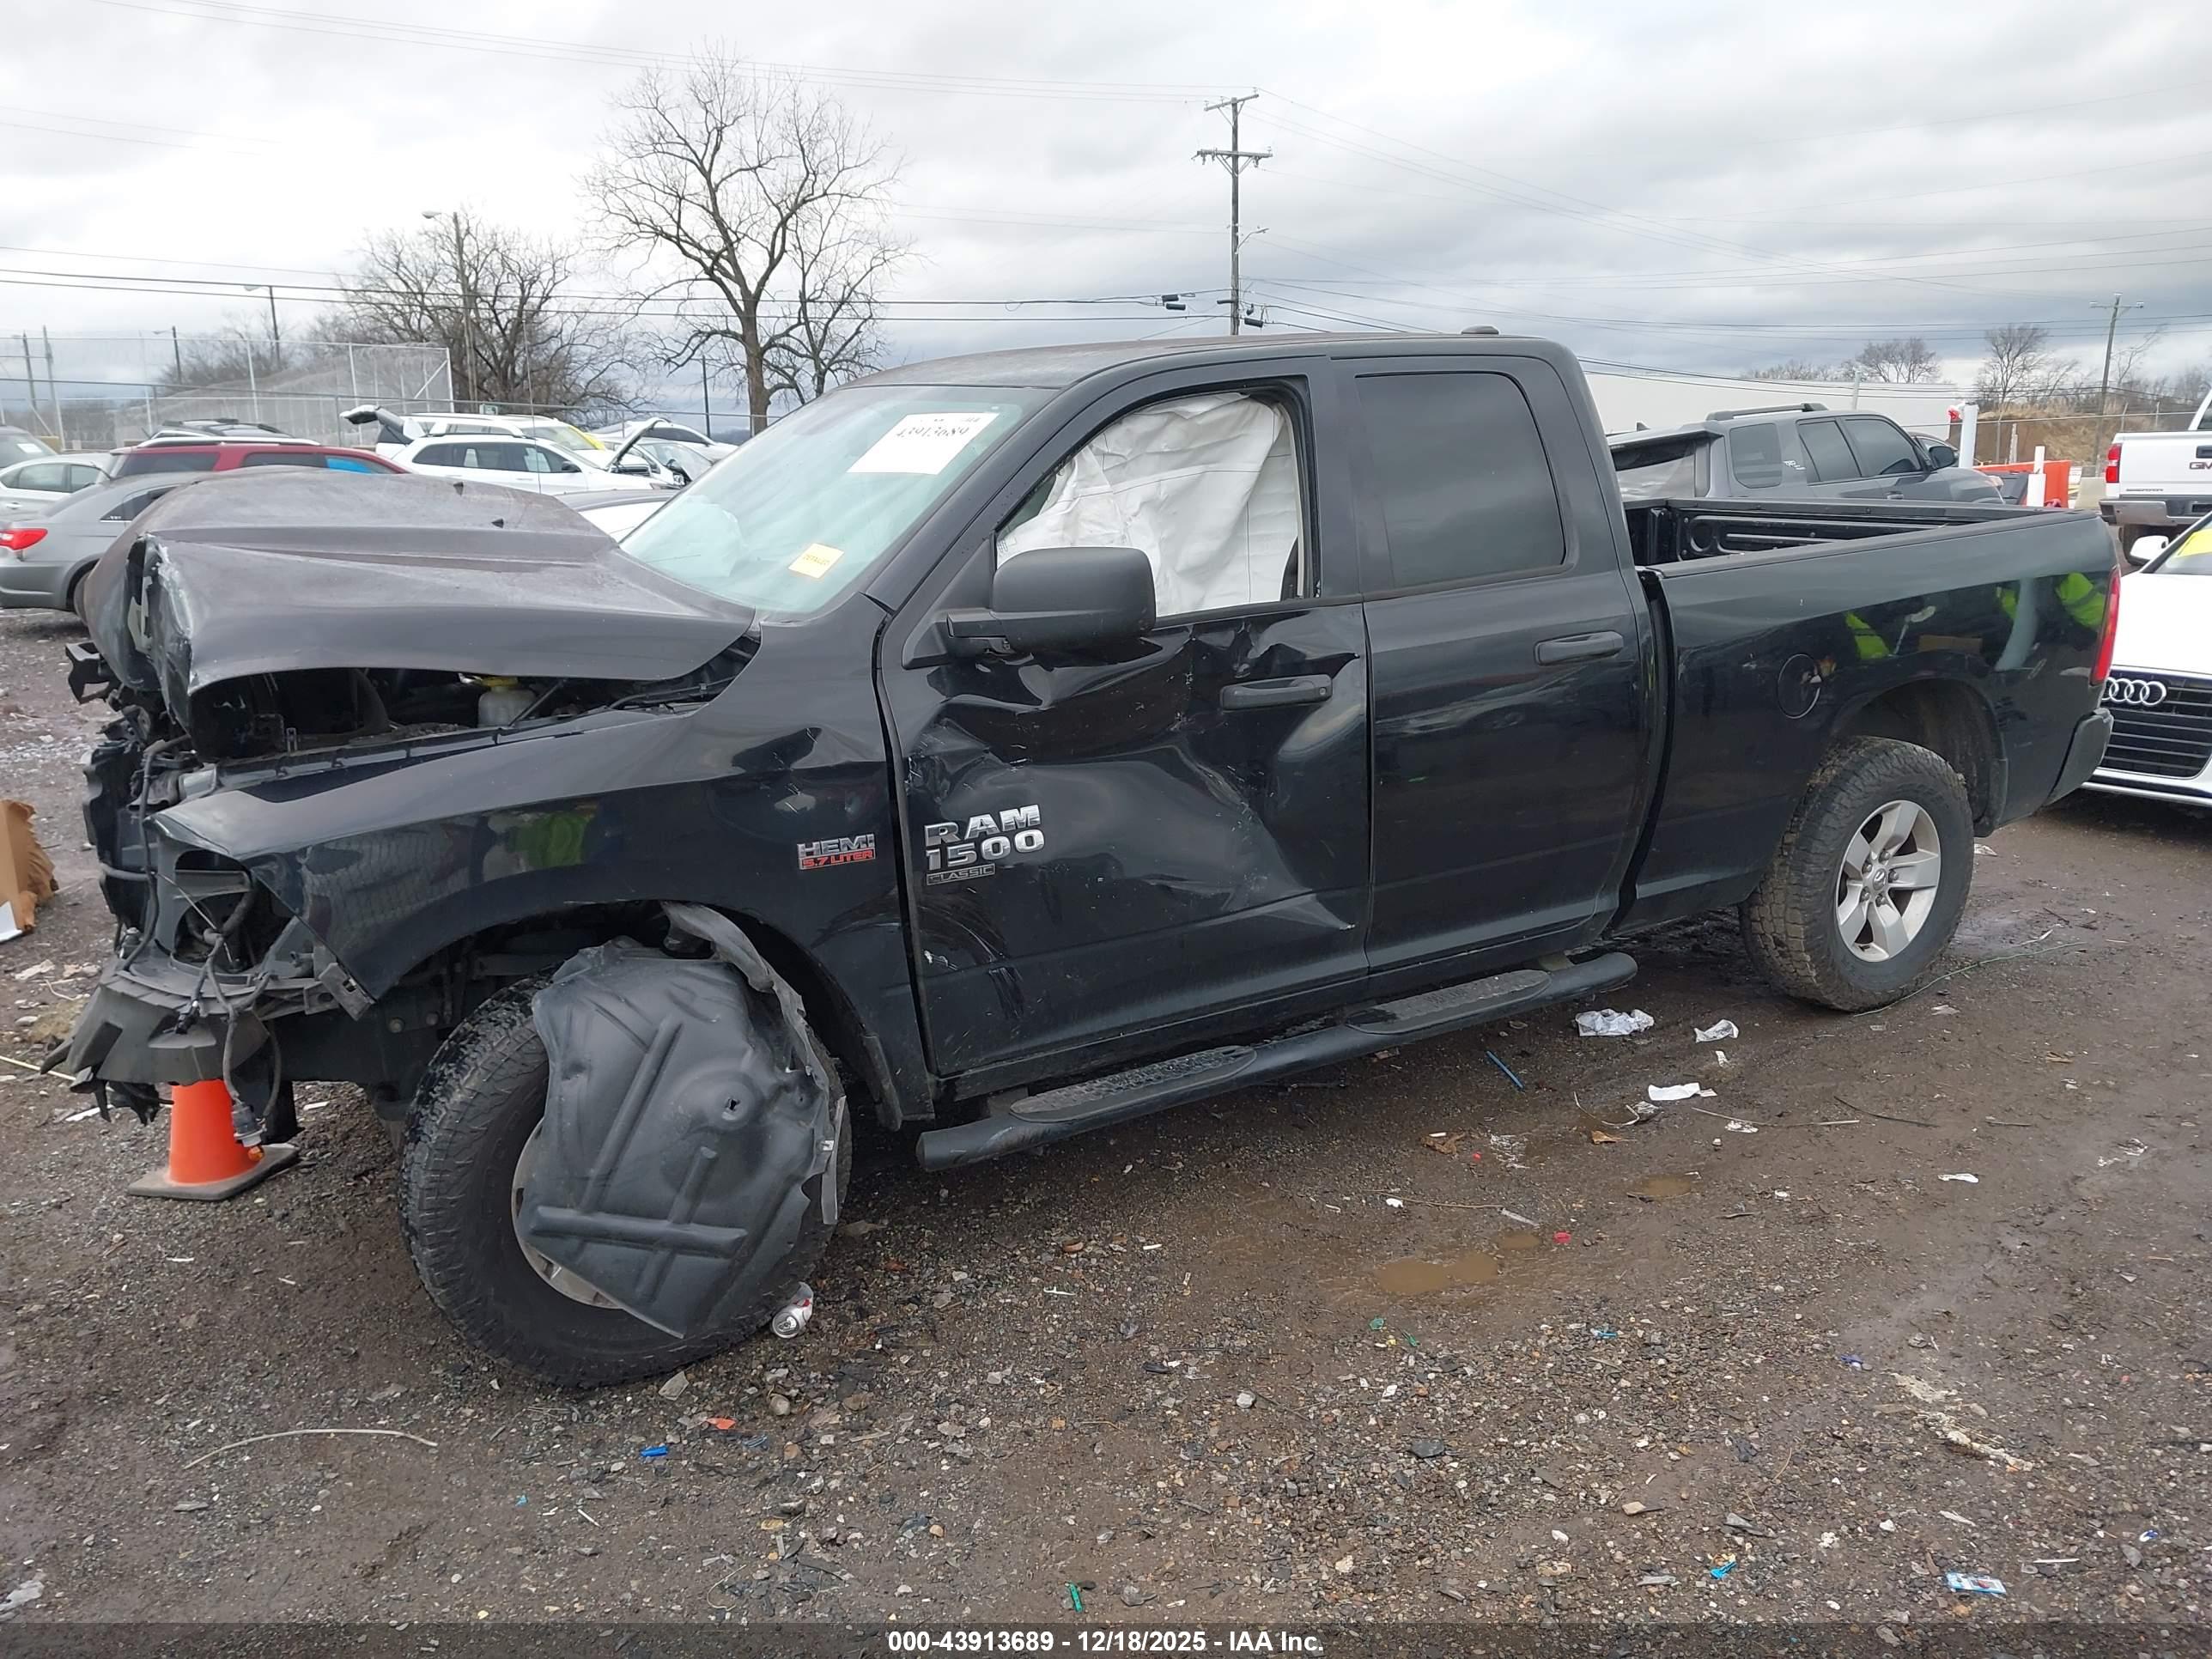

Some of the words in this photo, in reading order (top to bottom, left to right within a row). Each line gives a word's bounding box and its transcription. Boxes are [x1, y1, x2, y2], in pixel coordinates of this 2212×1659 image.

[924, 804, 1042, 847] RAM
[796, 833, 876, 859] HEMI
[802, 857, 830, 868] 5.7
[830, 849, 873, 864] LITER
[926, 829, 1045, 871] 1500
[928, 864, 994, 884] CLASSIC
